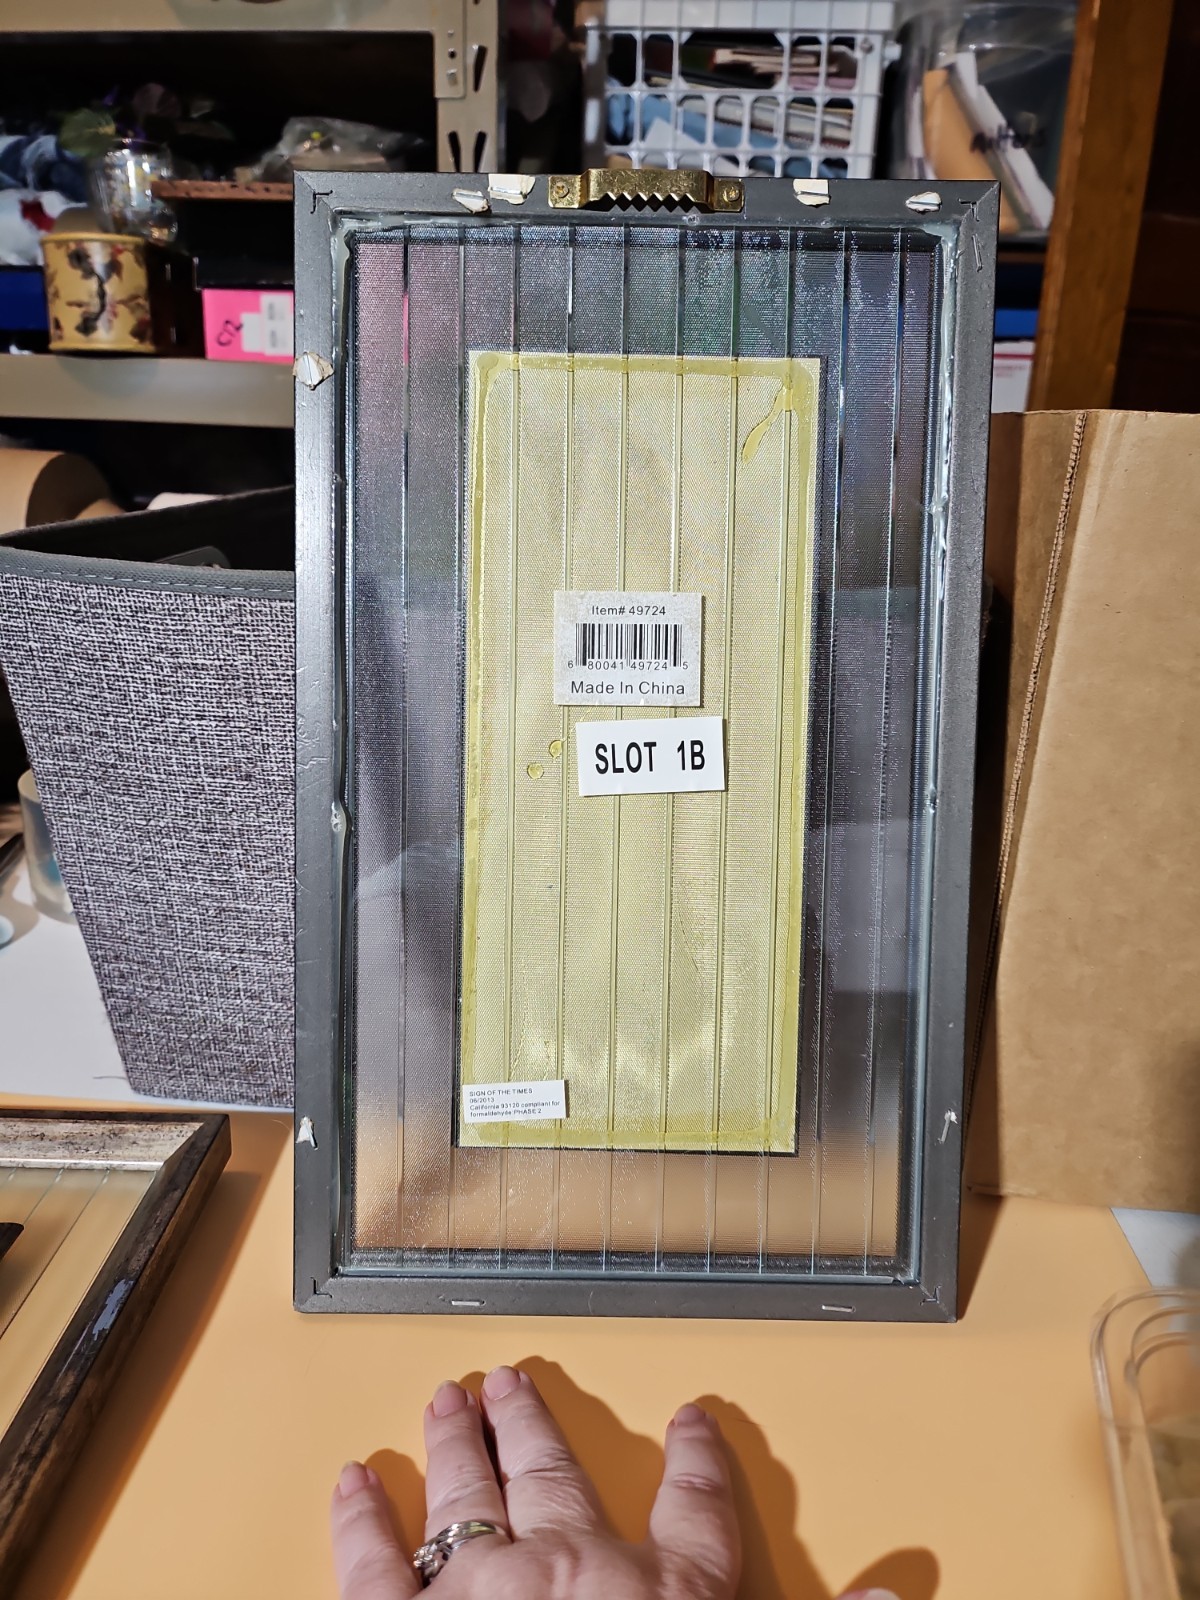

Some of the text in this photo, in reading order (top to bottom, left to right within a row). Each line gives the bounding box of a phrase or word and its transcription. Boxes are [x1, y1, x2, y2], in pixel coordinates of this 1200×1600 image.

[591, 605, 666, 616] Item# 49724
[567, 660, 689, 671] 6 80041 49724 5
[571, 680, 685, 695] Made In China
[595, 739, 705, 775] SLOT 1B
[470, 1103, 500, 1111] California
[521, 1101, 551, 1109] compliant
